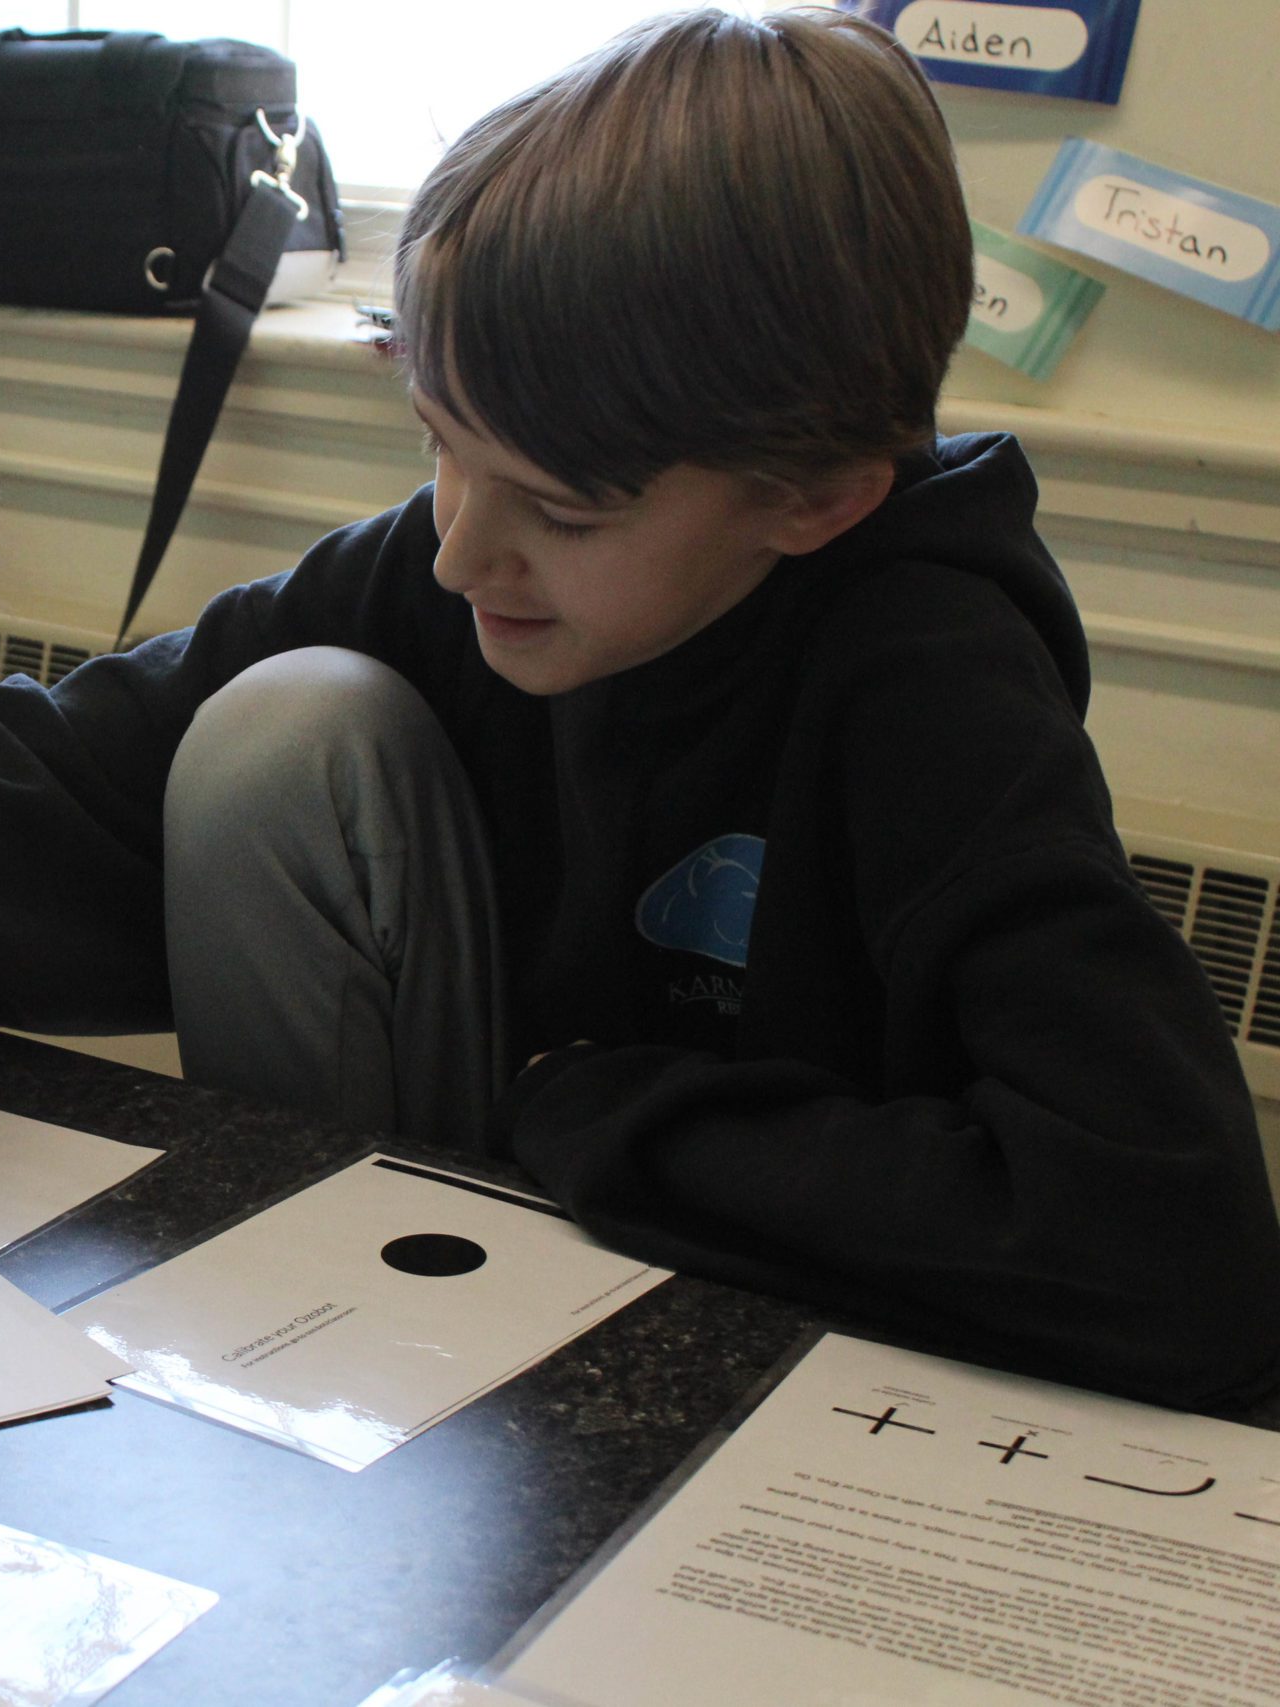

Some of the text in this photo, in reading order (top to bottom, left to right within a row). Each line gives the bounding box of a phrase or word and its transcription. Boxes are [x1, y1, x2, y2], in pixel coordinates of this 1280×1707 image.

[917, 17, 1033, 59] Aiden
[1104, 183, 1229, 265] Tristan
[973, 284, 1009, 318] en
[222, 1303, 337, 1363] Calibrate your Ozobot
